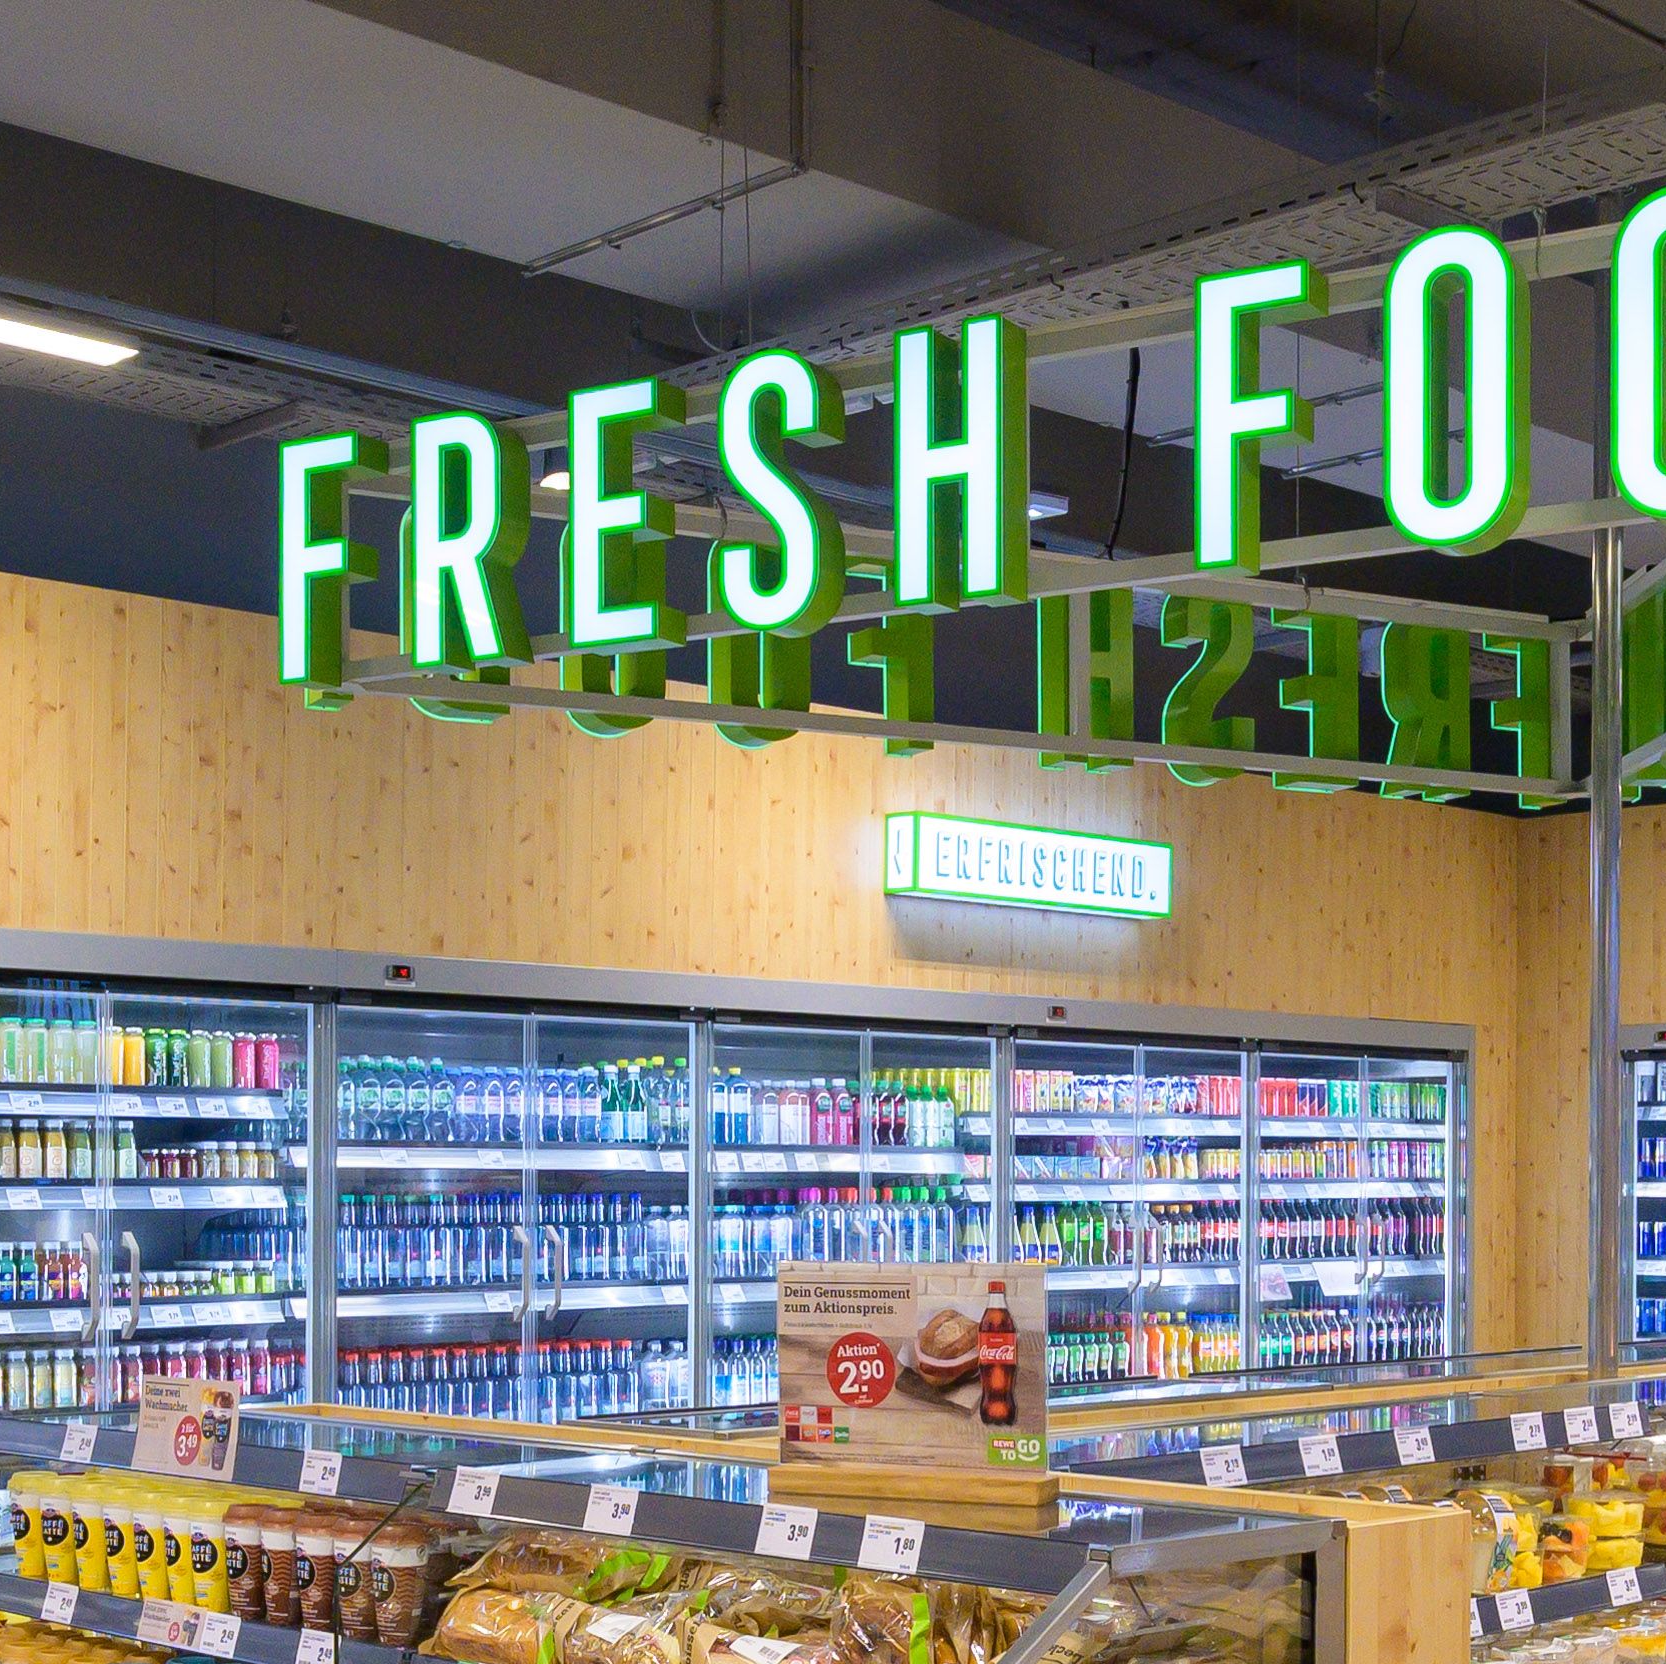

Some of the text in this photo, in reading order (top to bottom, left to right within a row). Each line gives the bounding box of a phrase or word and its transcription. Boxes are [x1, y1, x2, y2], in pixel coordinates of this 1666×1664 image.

[277, 312, 1029, 690] FRESH
[935, 830, 1159, 900] ERFRISCHEND.
[783, 1285, 912, 1301] Dein Genussmoment
[783, 1302, 899, 1317] zum Aktionspreis.
[836, 1358, 886, 1394] 2.90
[176, 1435, 199, 1458] 3.49
[992, 1438, 1041, 1454] REWE GO
[1000, 1448, 1017, 1461] TO
[611, 1502, 631, 1520] 3.90
[787, 1523, 809, 1543] 3.90
[893, 1535, 916, 1557] 1.80
